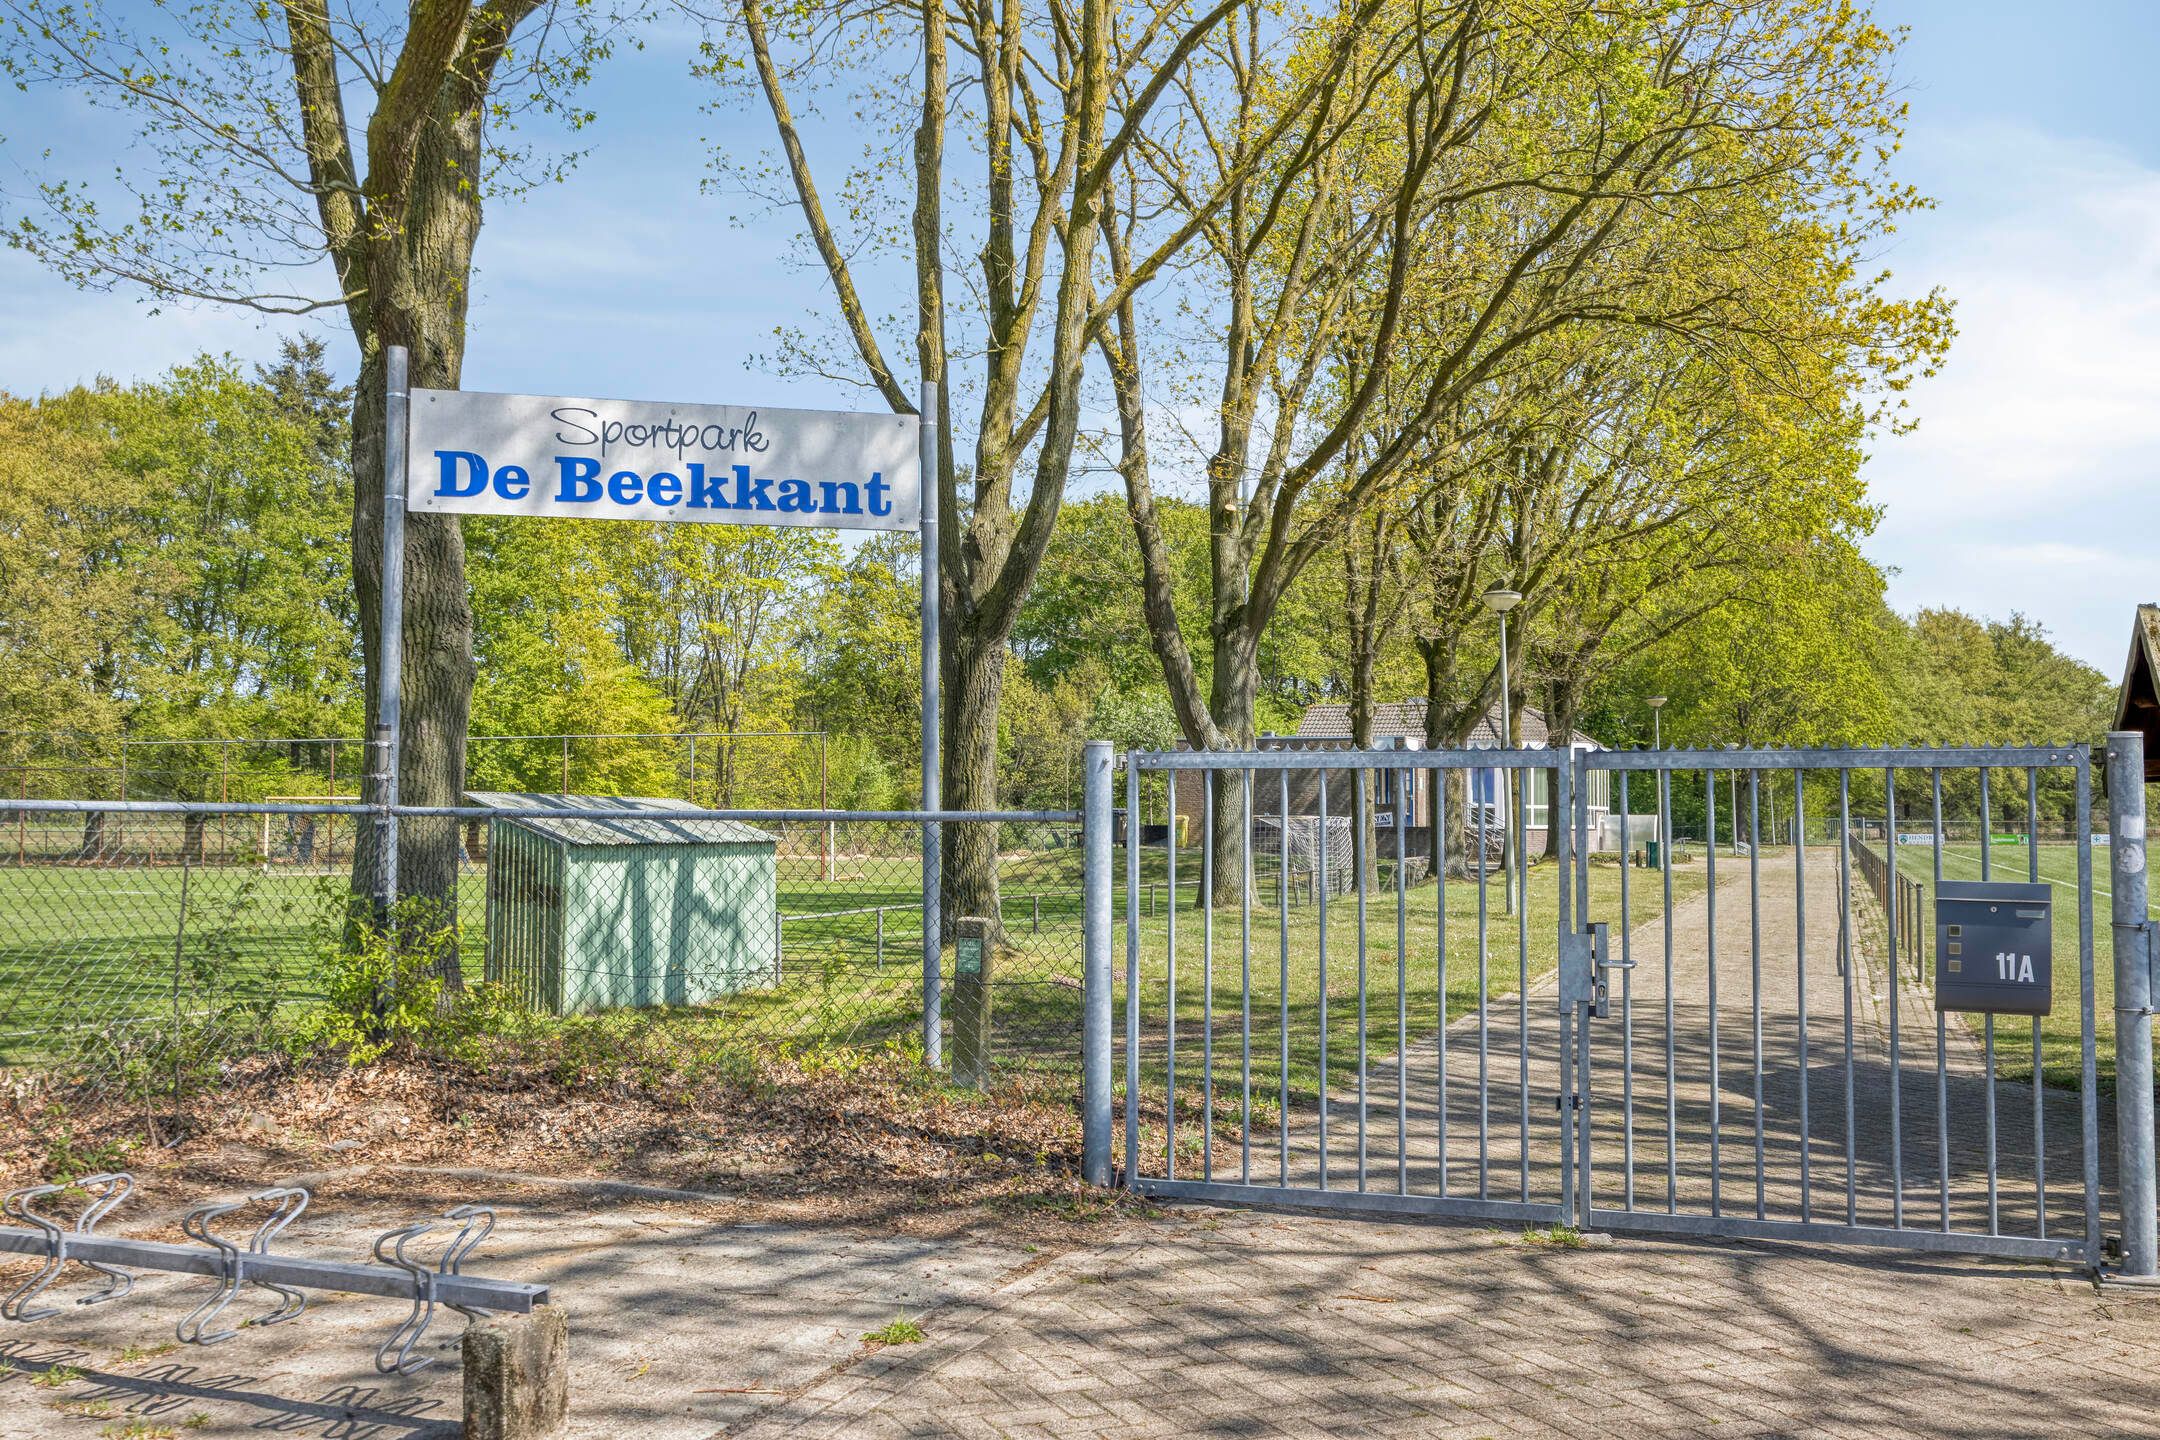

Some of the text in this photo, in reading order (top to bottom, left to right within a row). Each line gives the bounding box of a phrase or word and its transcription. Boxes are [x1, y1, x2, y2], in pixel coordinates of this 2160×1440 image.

[550, 407, 769, 460] Sportpark
[433, 450, 892, 517] De Beekkant
[1995, 952, 2035, 983] 11A
